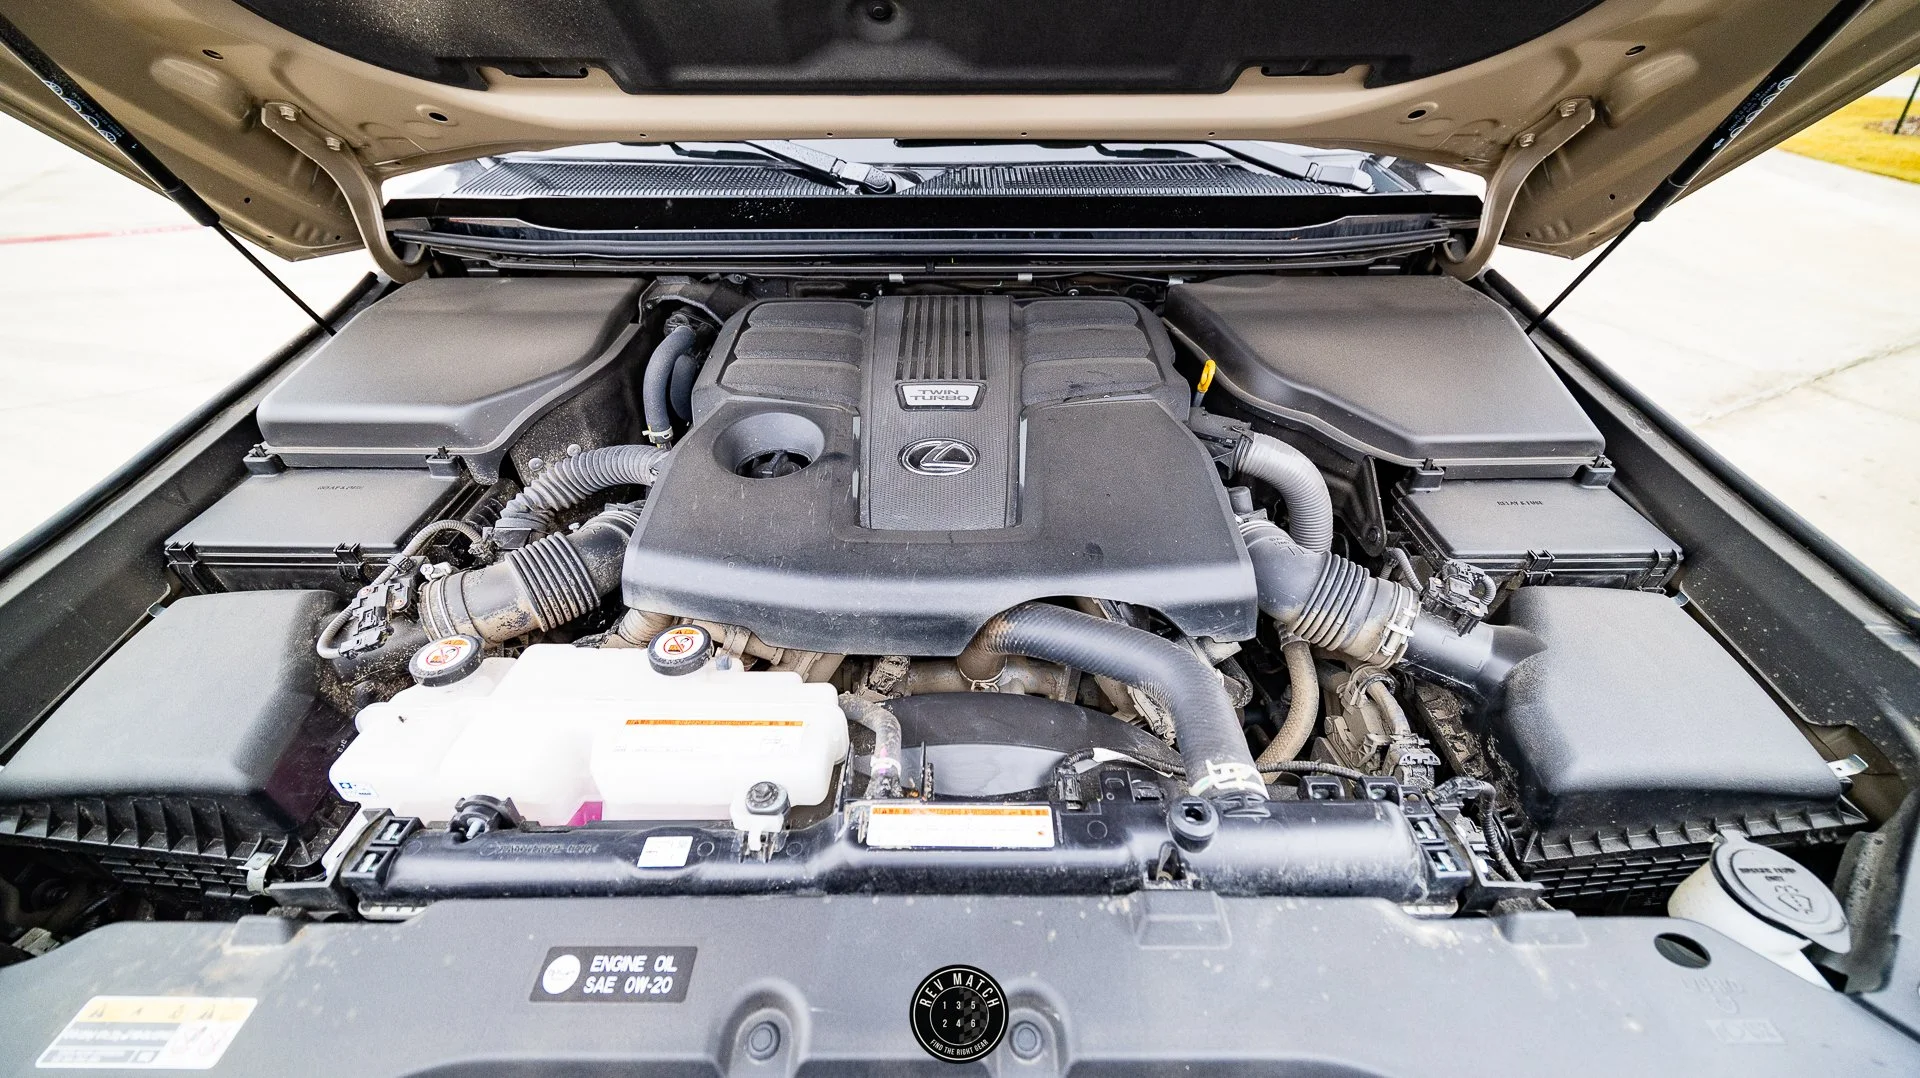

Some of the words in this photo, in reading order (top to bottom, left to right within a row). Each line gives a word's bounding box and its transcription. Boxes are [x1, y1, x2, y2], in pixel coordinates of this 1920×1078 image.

[589, 955, 648, 973] ENGINE
[654, 955, 678, 973] OIL
[583, 976, 618, 994] SAE
[624, 976, 673, 994] 0W-20
